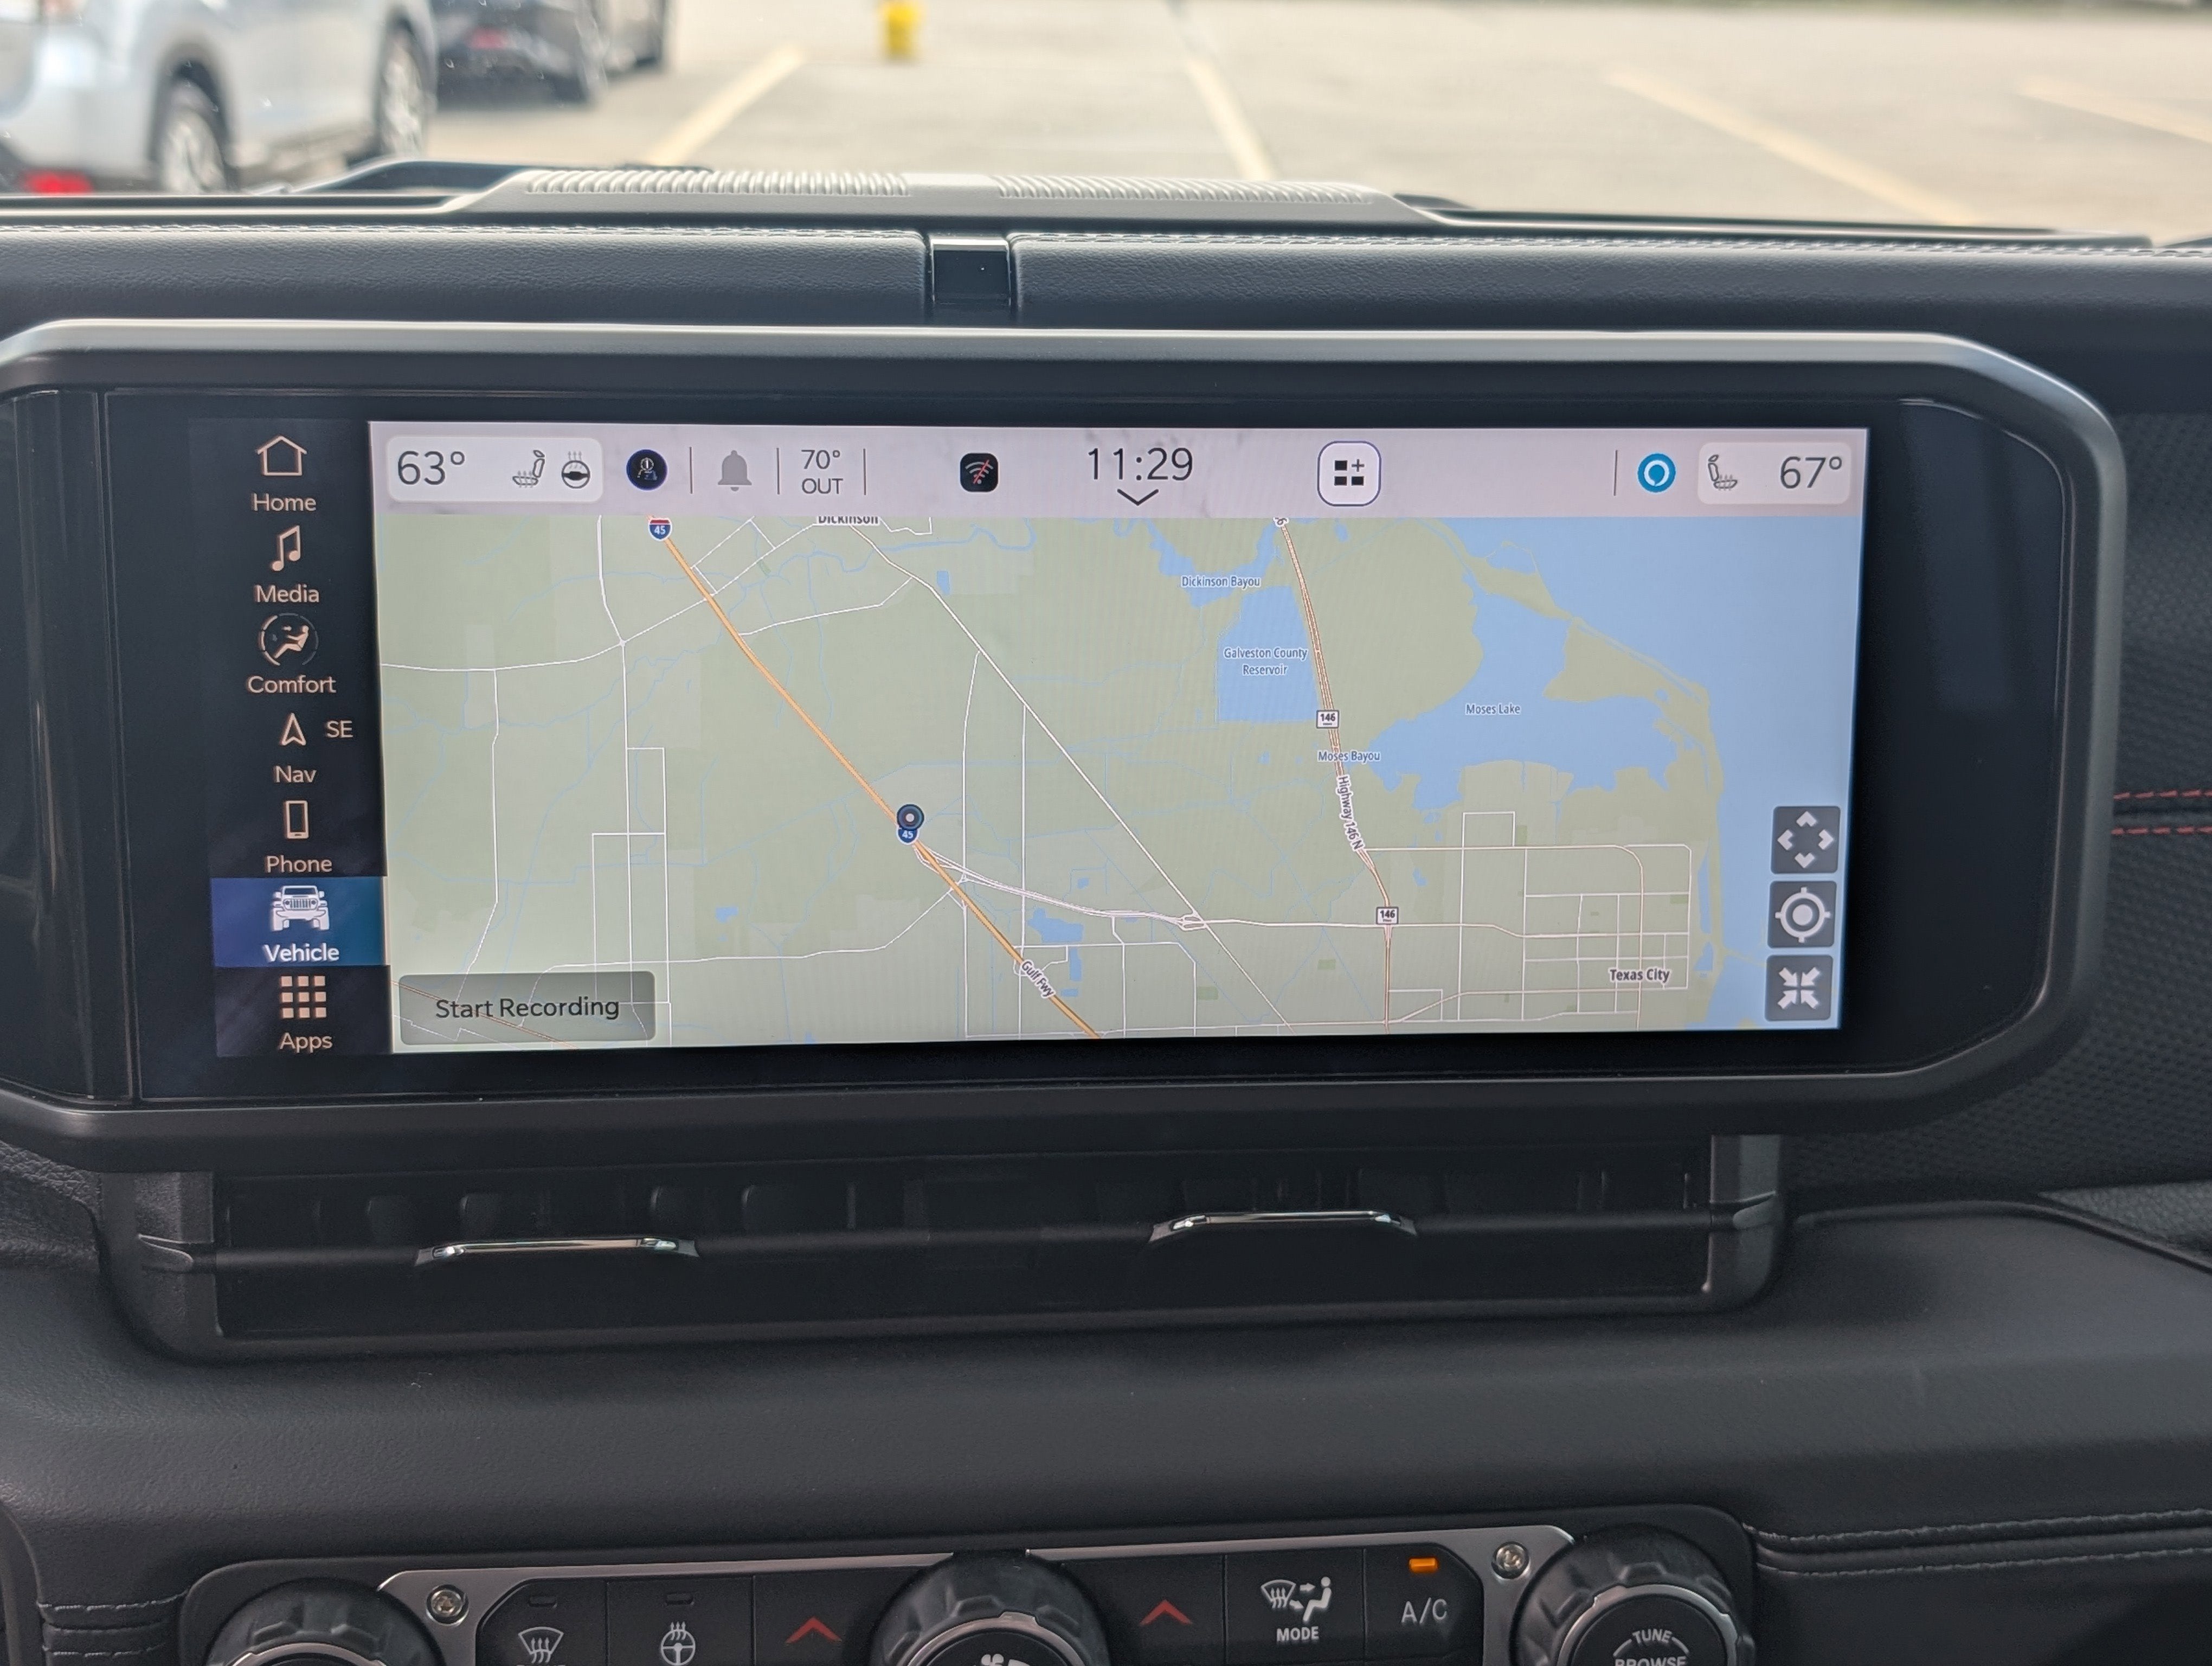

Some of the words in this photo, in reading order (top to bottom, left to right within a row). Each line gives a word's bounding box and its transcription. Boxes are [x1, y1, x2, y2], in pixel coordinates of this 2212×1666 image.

[397, 450, 465, 486] 63°
[801, 449, 841, 470] 70°
[1088, 447, 1193, 481] 11:29
[1780, 456, 1842, 489] 67°
[801, 478, 843, 495] OUT
[252, 493, 317, 513] Home
[654, 526, 666, 535] 45
[1182, 576, 1228, 587] Dickinson
[1231, 576, 1261, 589] Bayou
[254, 585, 320, 603] Media
[1224, 648, 1271, 658] Galveston
[1274, 649, 1307, 661] County
[1243, 665, 1288, 675] Reservoir
[247, 676, 337, 694] Comfort
[1320, 713, 1335, 722] 146
[1466, 704, 1496, 715] Moses
[1499, 704, 1520, 715] Lake
[325, 721, 353, 738] SE
[1319, 752, 1348, 761] Moses
[1351, 751, 1380, 764] Bayou
[274, 766, 316, 783] Nav
[1337, 776, 1353, 819] Highway
[902, 830, 914, 839] 45
[1346, 822, 1360, 840] 146
[1352, 840, 1364, 850] N
[266, 855, 332, 873] Phone
[1380, 909, 1396, 918] 146
[263, 944, 339, 962] Vehicle
[1022, 961, 1043, 980] Gulf
[1037, 978, 1054, 997] Fwy
[1610, 969, 1643, 981] Texas
[1646, 969, 1670, 983] City
[435, 999, 494, 1018] Start
[500, 997, 620, 1020] Recording
[279, 1033, 333, 1053] Apps
[1401, 1598, 1447, 1624] A/C
[1276, 1626, 1319, 1642] MODE
[1632, 1629, 1673, 1644] TUNE
